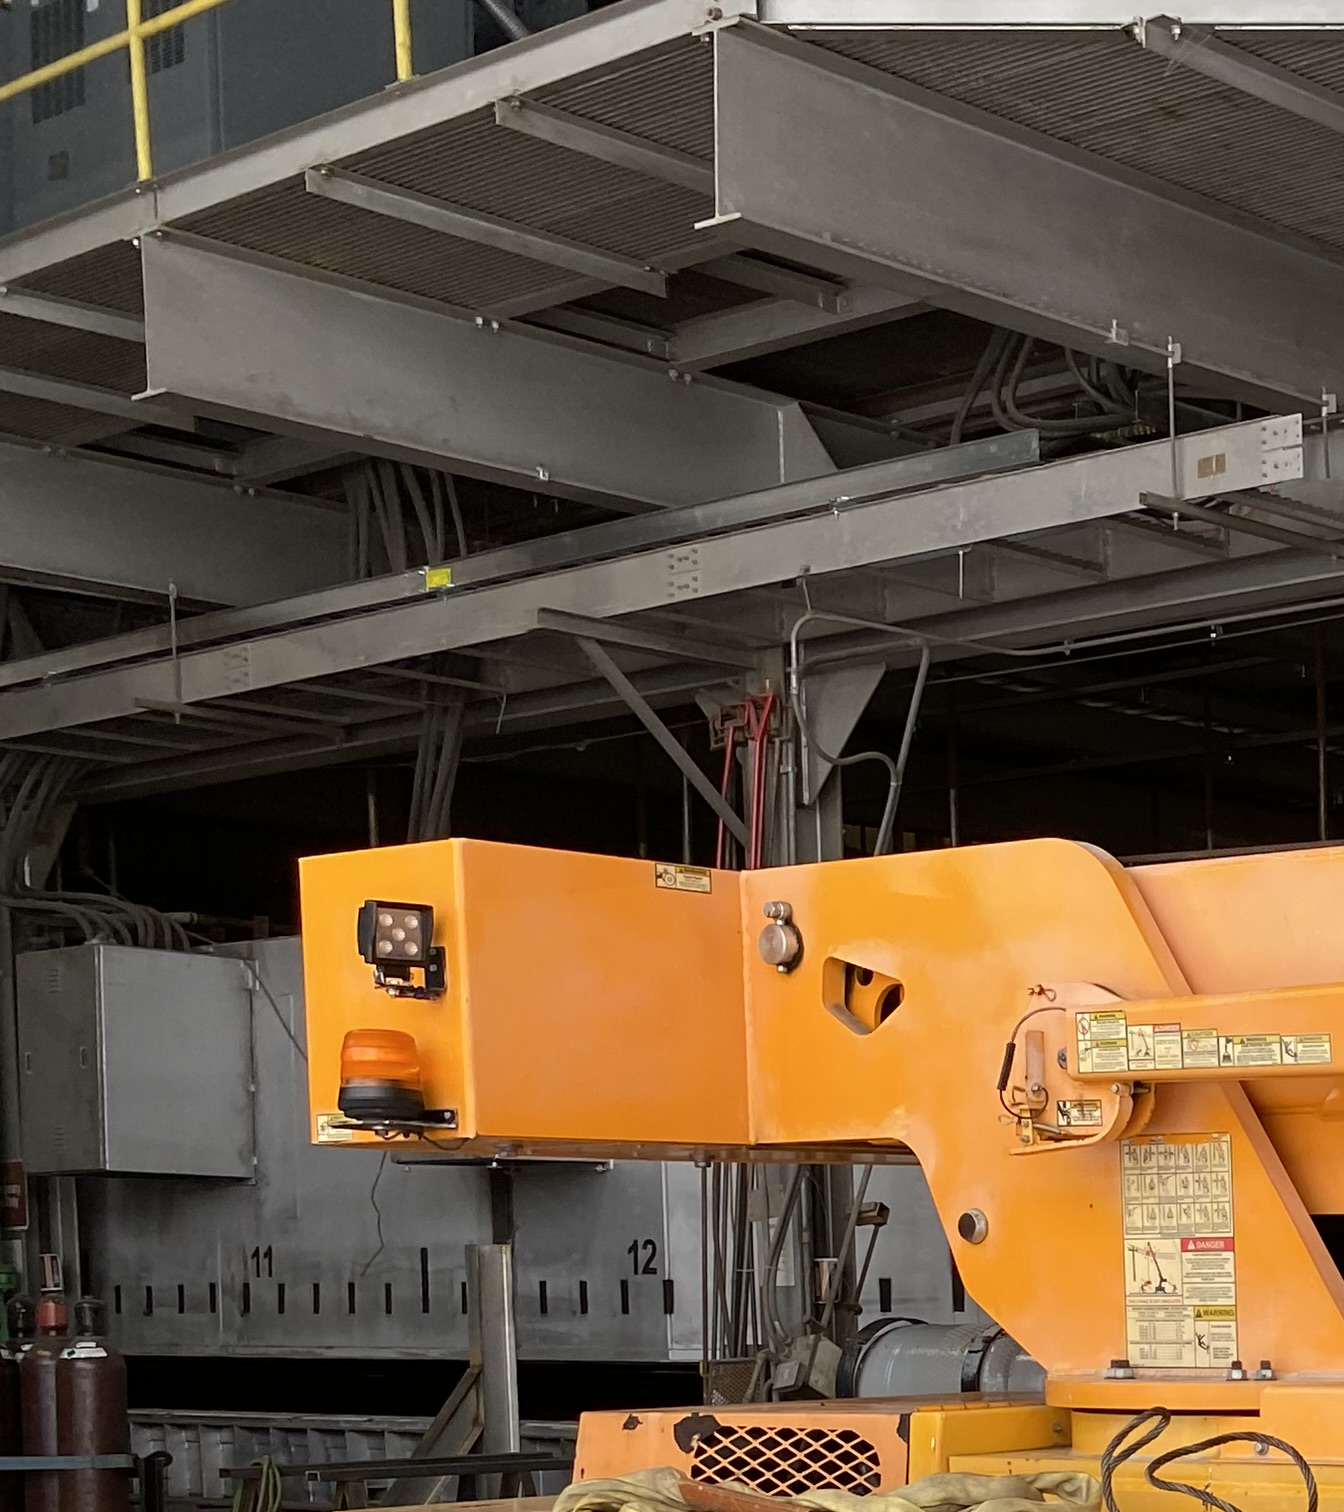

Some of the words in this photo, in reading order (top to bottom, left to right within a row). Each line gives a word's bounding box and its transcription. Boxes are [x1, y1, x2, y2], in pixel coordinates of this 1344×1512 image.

[1196, 1240, 1225, 1249] DANGER
[251, 1245, 273, 1278] 11
[628, 1239, 658, 1276] 12
[1202, 1309, 1235, 1317] WARNING
